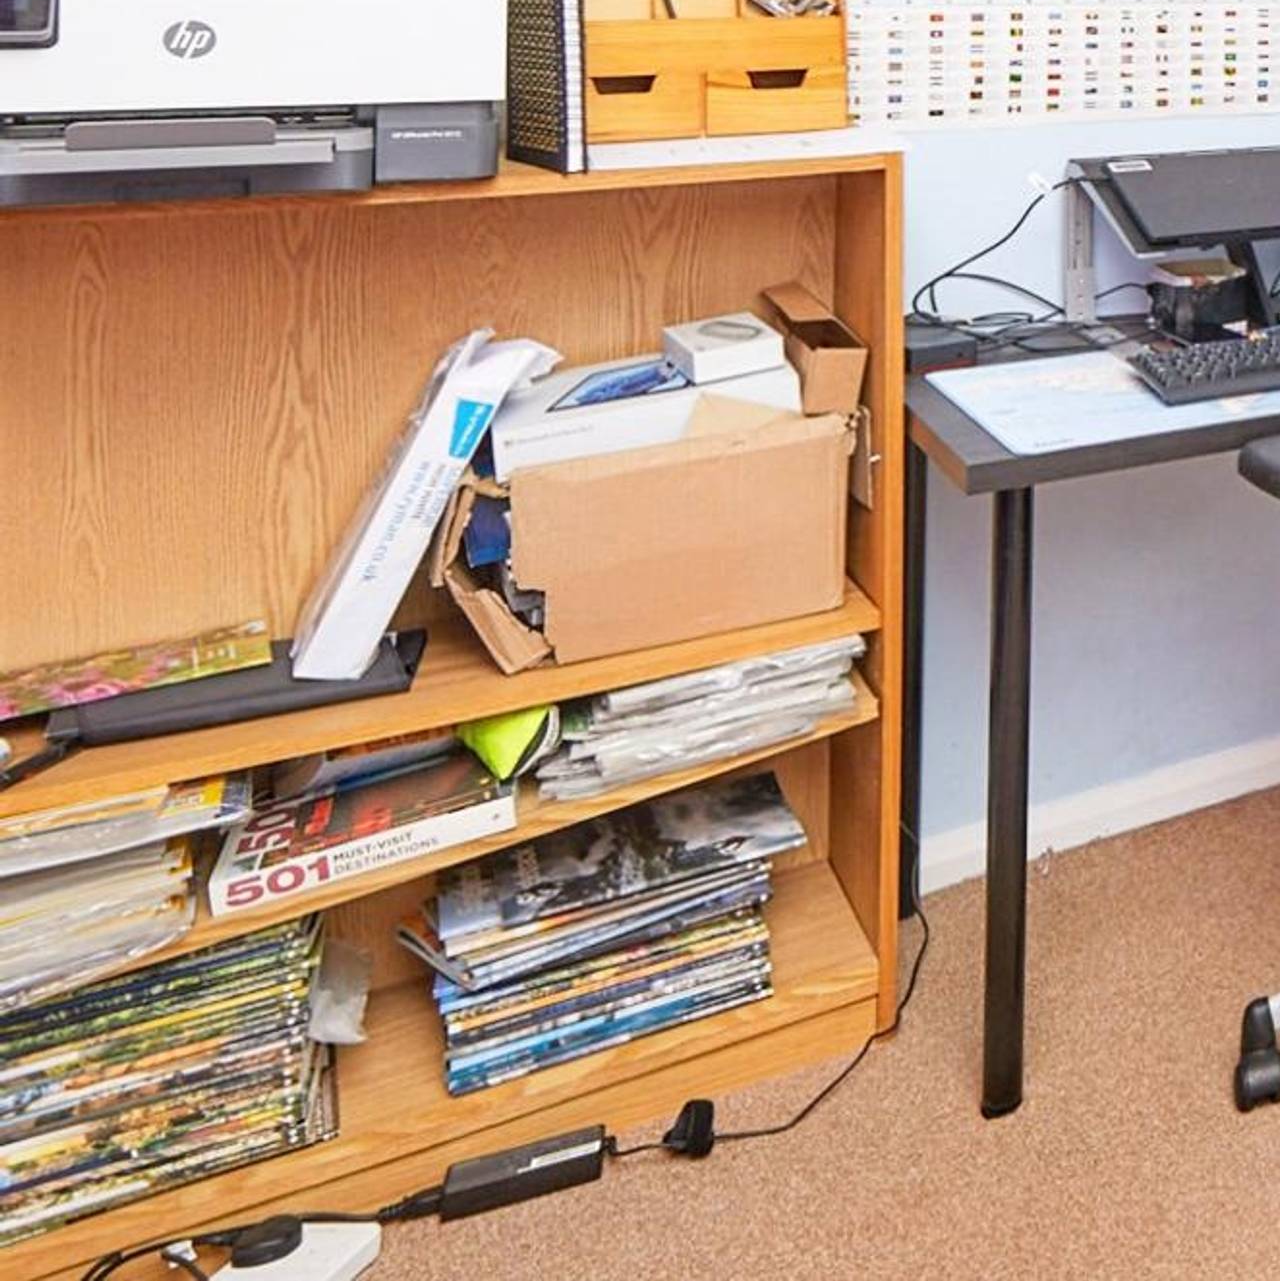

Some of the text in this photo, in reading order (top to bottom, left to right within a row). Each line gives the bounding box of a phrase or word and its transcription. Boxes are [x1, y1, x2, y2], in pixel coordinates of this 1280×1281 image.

[169, 19, 212, 60] hp
[333, 830, 413, 864] MUST-VISIT
[333, 837, 441, 875] DESTINATIONS
[226, 855, 332, 907] 501
